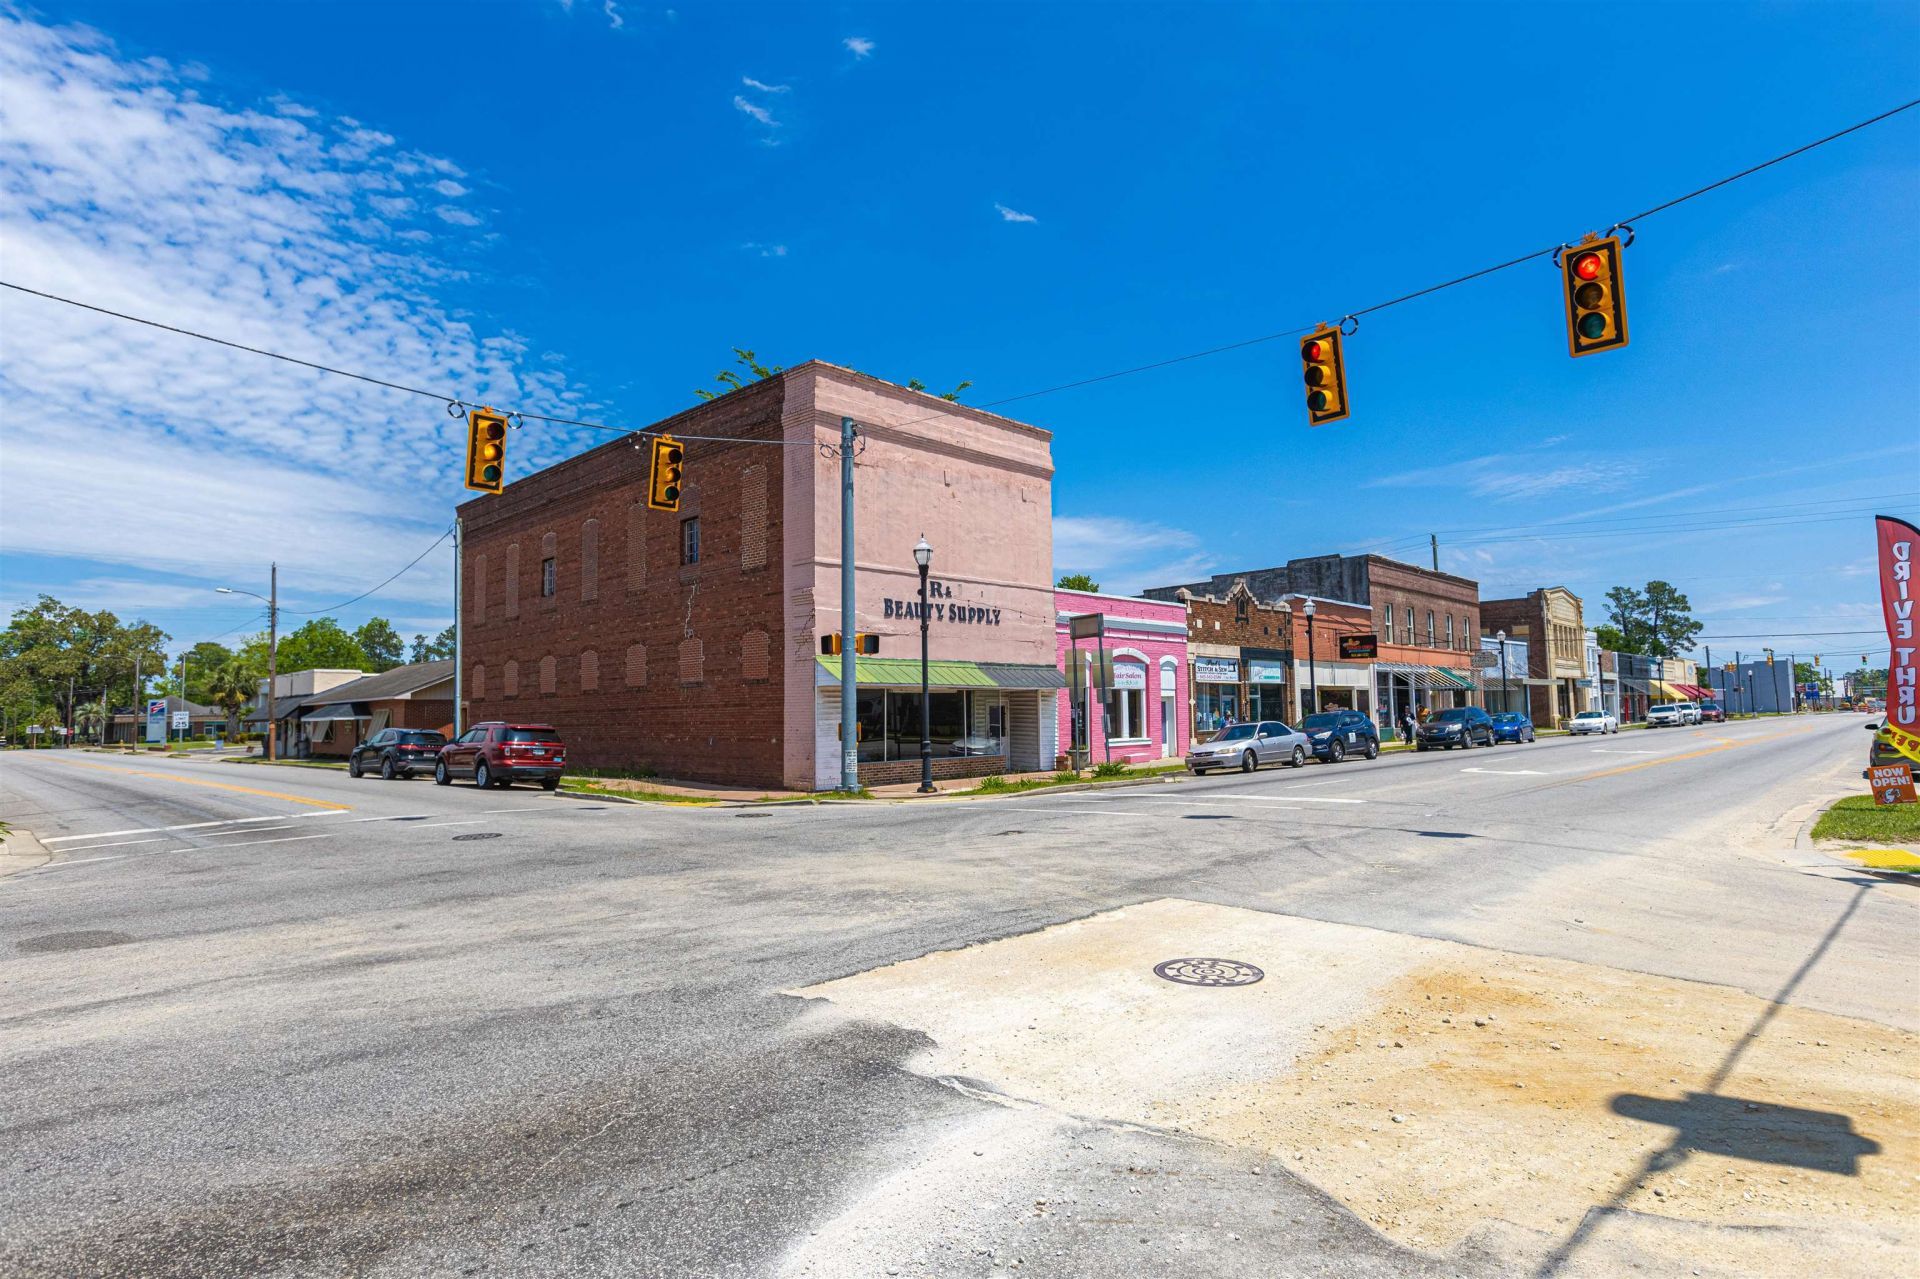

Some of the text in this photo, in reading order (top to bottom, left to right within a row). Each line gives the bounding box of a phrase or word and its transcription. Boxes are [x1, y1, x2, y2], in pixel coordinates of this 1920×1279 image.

[1125, 671, 1142, 679] Salon
[1873, 767, 1904, 778] NOW
[1872, 776, 1911, 788] OPEN!
